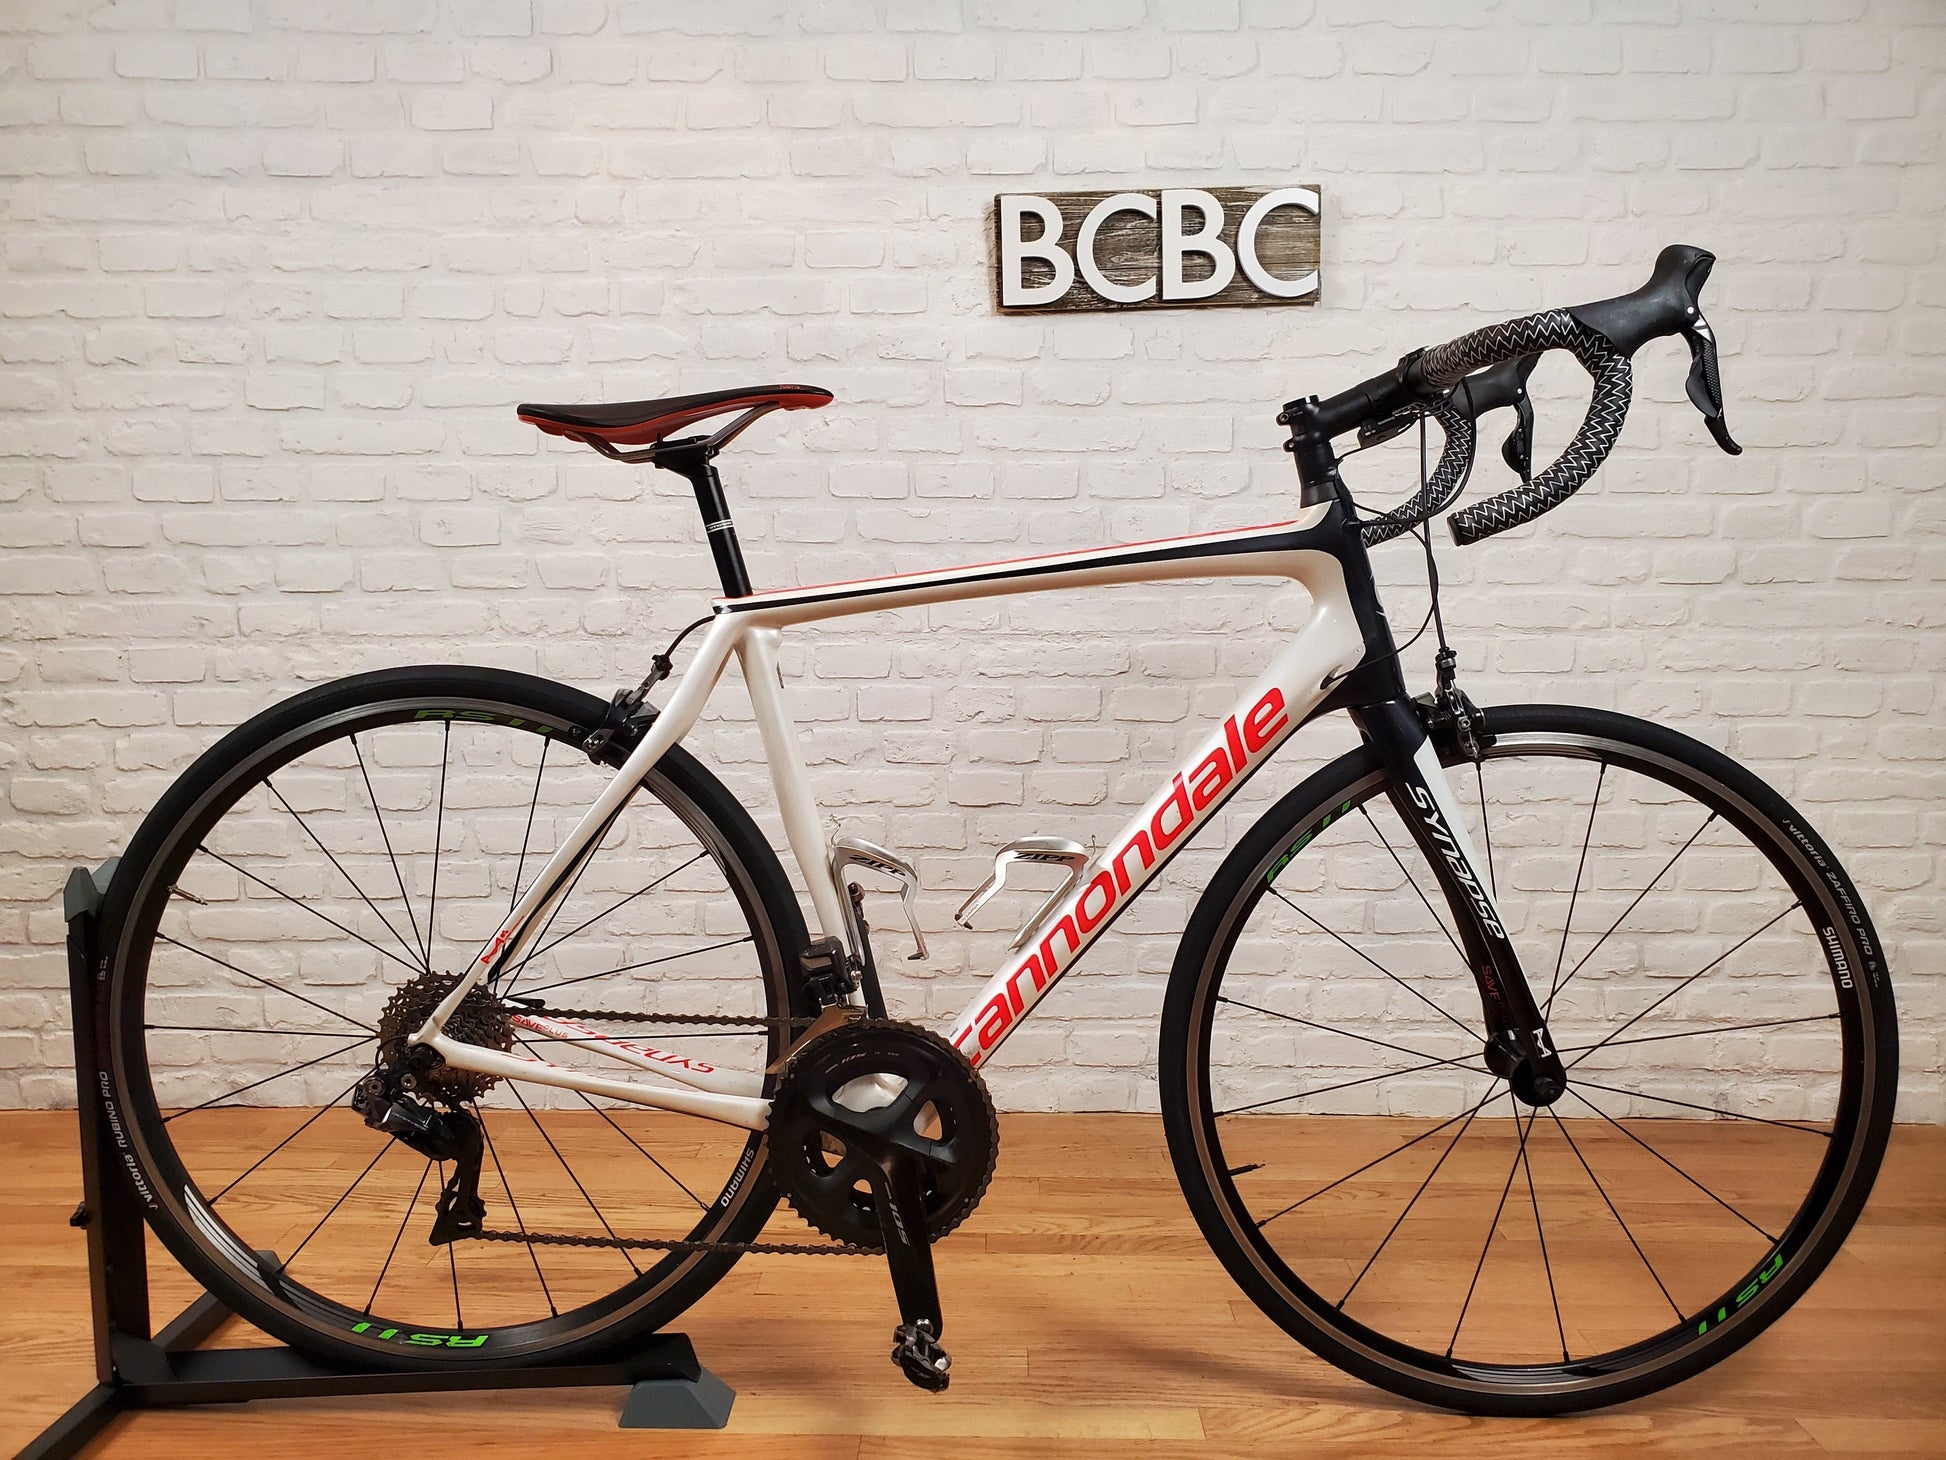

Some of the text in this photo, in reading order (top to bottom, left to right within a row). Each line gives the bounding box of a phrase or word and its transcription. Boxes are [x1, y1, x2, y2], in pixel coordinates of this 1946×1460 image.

[1000, 187, 1320, 307] BCBC
[1013, 851, 1075, 862] ZIPP
[1826, 871, 1860, 925] ZAFFIRO
[1856, 927, 1873, 956] PRO
[1482, 965, 1501, 1000] SAVE
[1822, 926, 1853, 989] SHIMANO
[99, 1071, 110, 1098] PRO
[104, 1101, 127, 1148] RUBINO
[720, 1148, 755, 1208] SHIMANO
